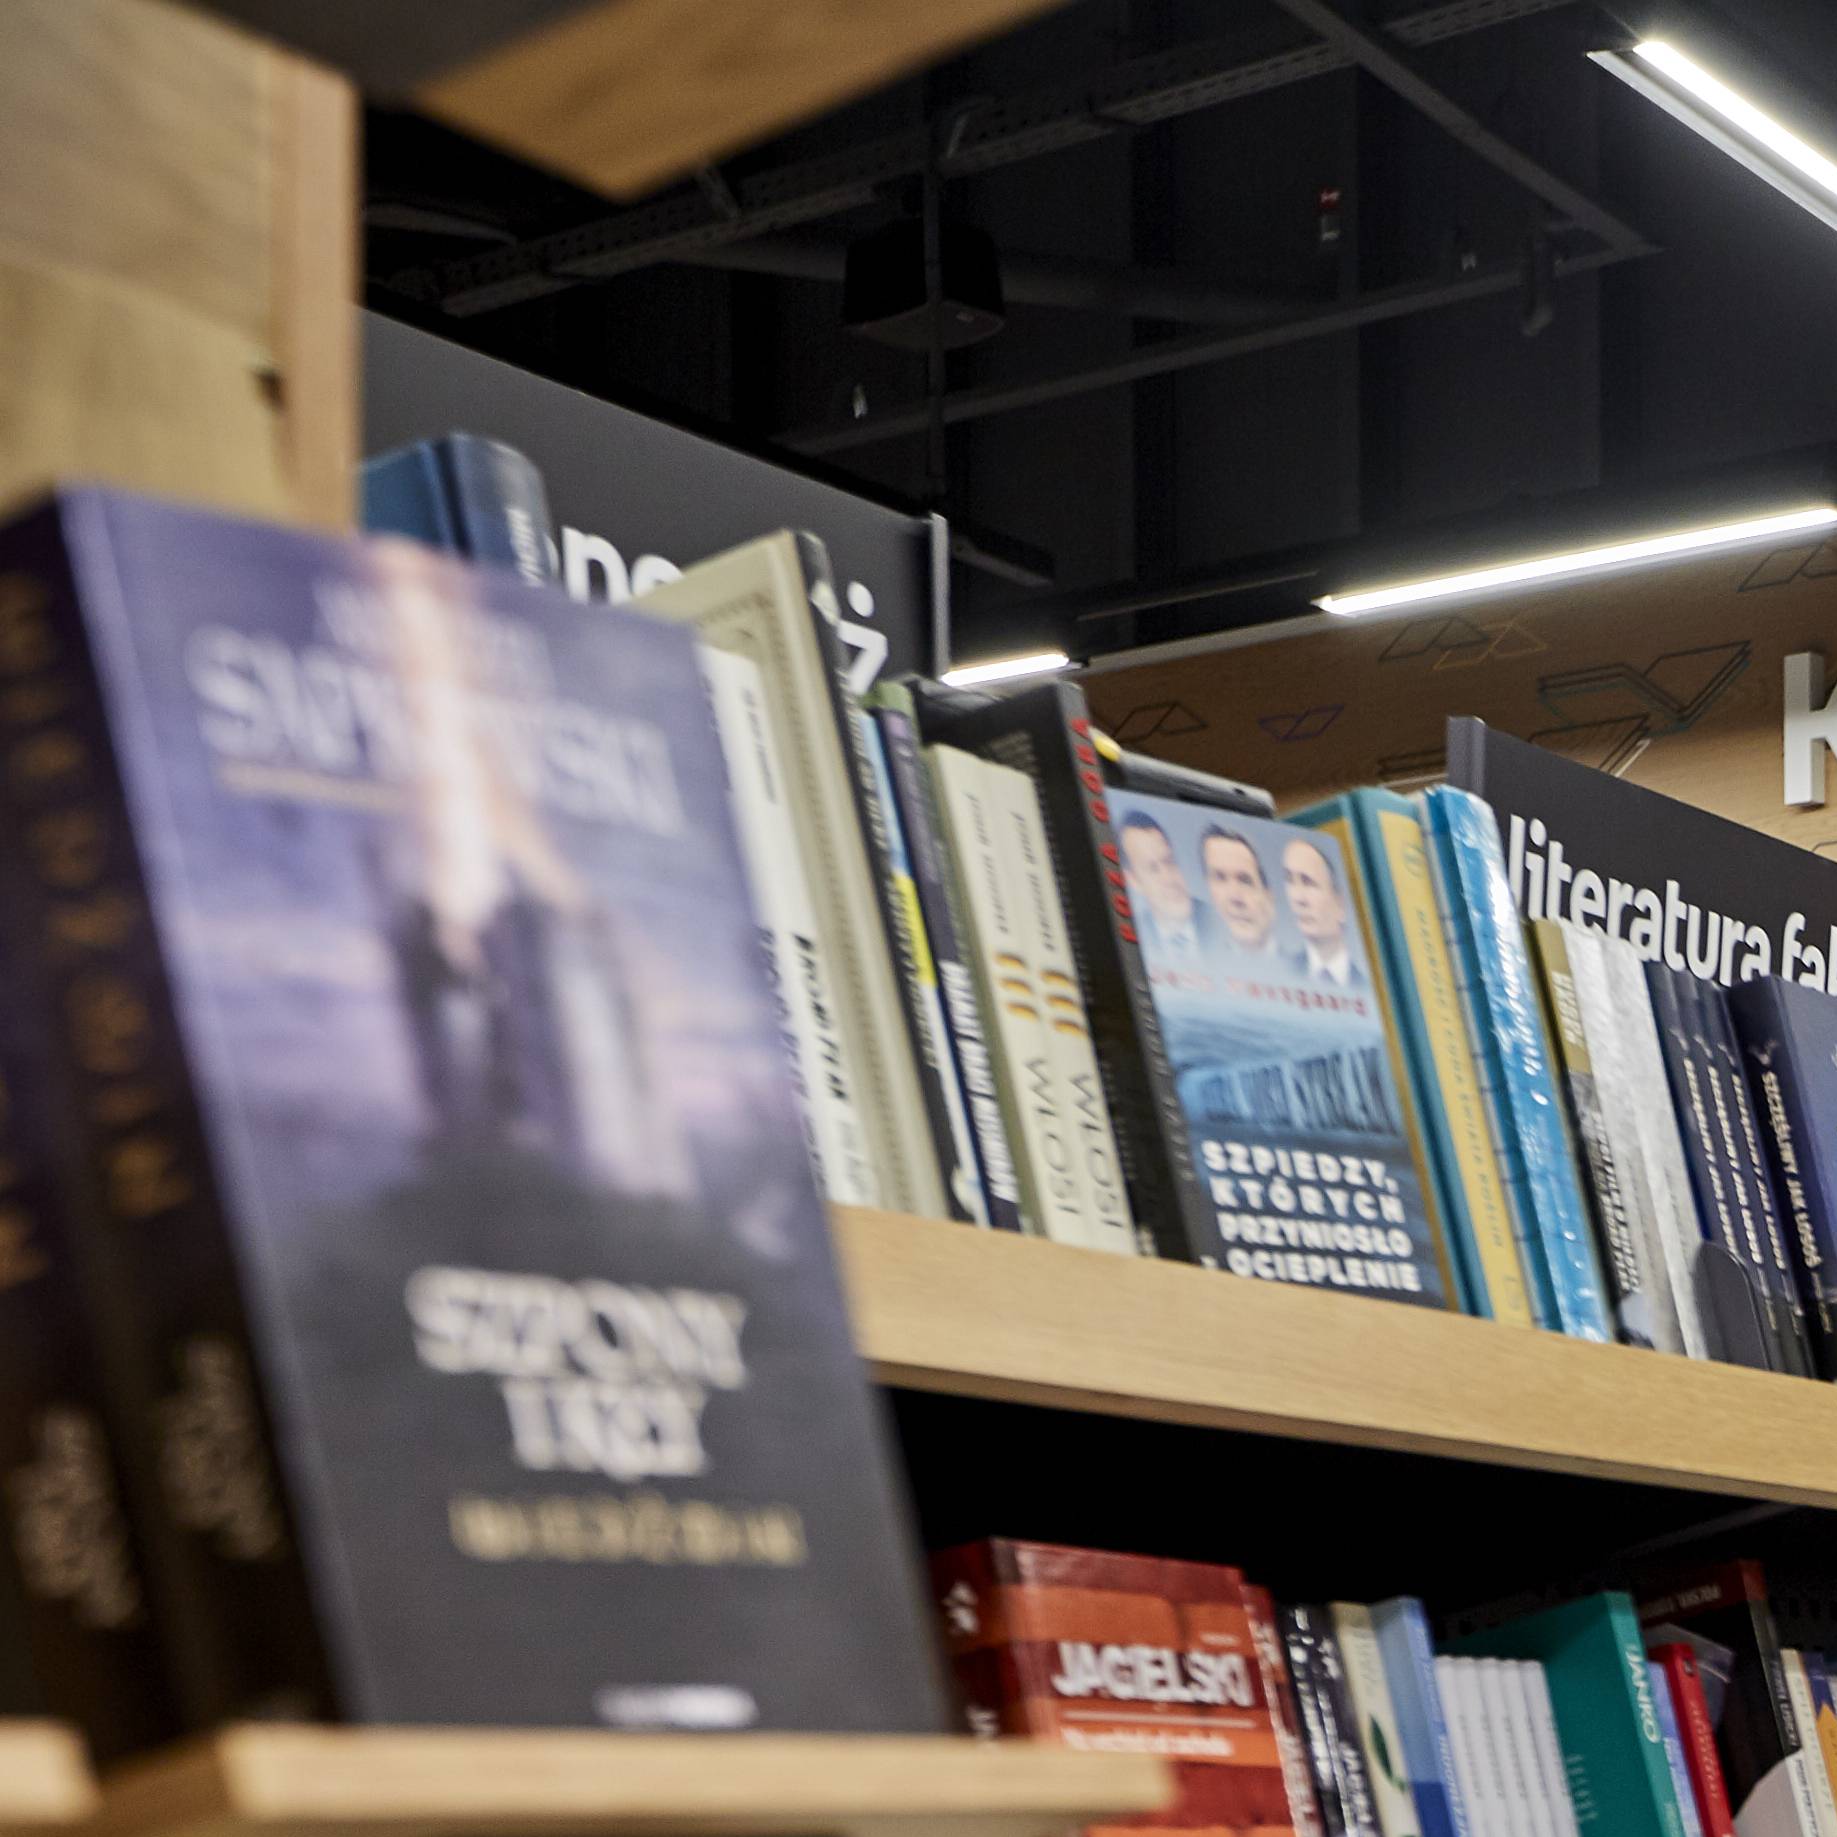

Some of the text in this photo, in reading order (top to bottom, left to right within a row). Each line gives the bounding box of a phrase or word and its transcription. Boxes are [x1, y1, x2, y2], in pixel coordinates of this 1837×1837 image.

[1509, 813, 1772, 982] literatura
[1201, 1139, 1399, 1193] SZPIEDZY,
[1208, 1177, 1406, 1224] KTÓRYCH
[1217, 1211, 1413, 1258] PRZYNIOSŁO
[1227, 1248, 1422, 1293] OCIEPLENIE
